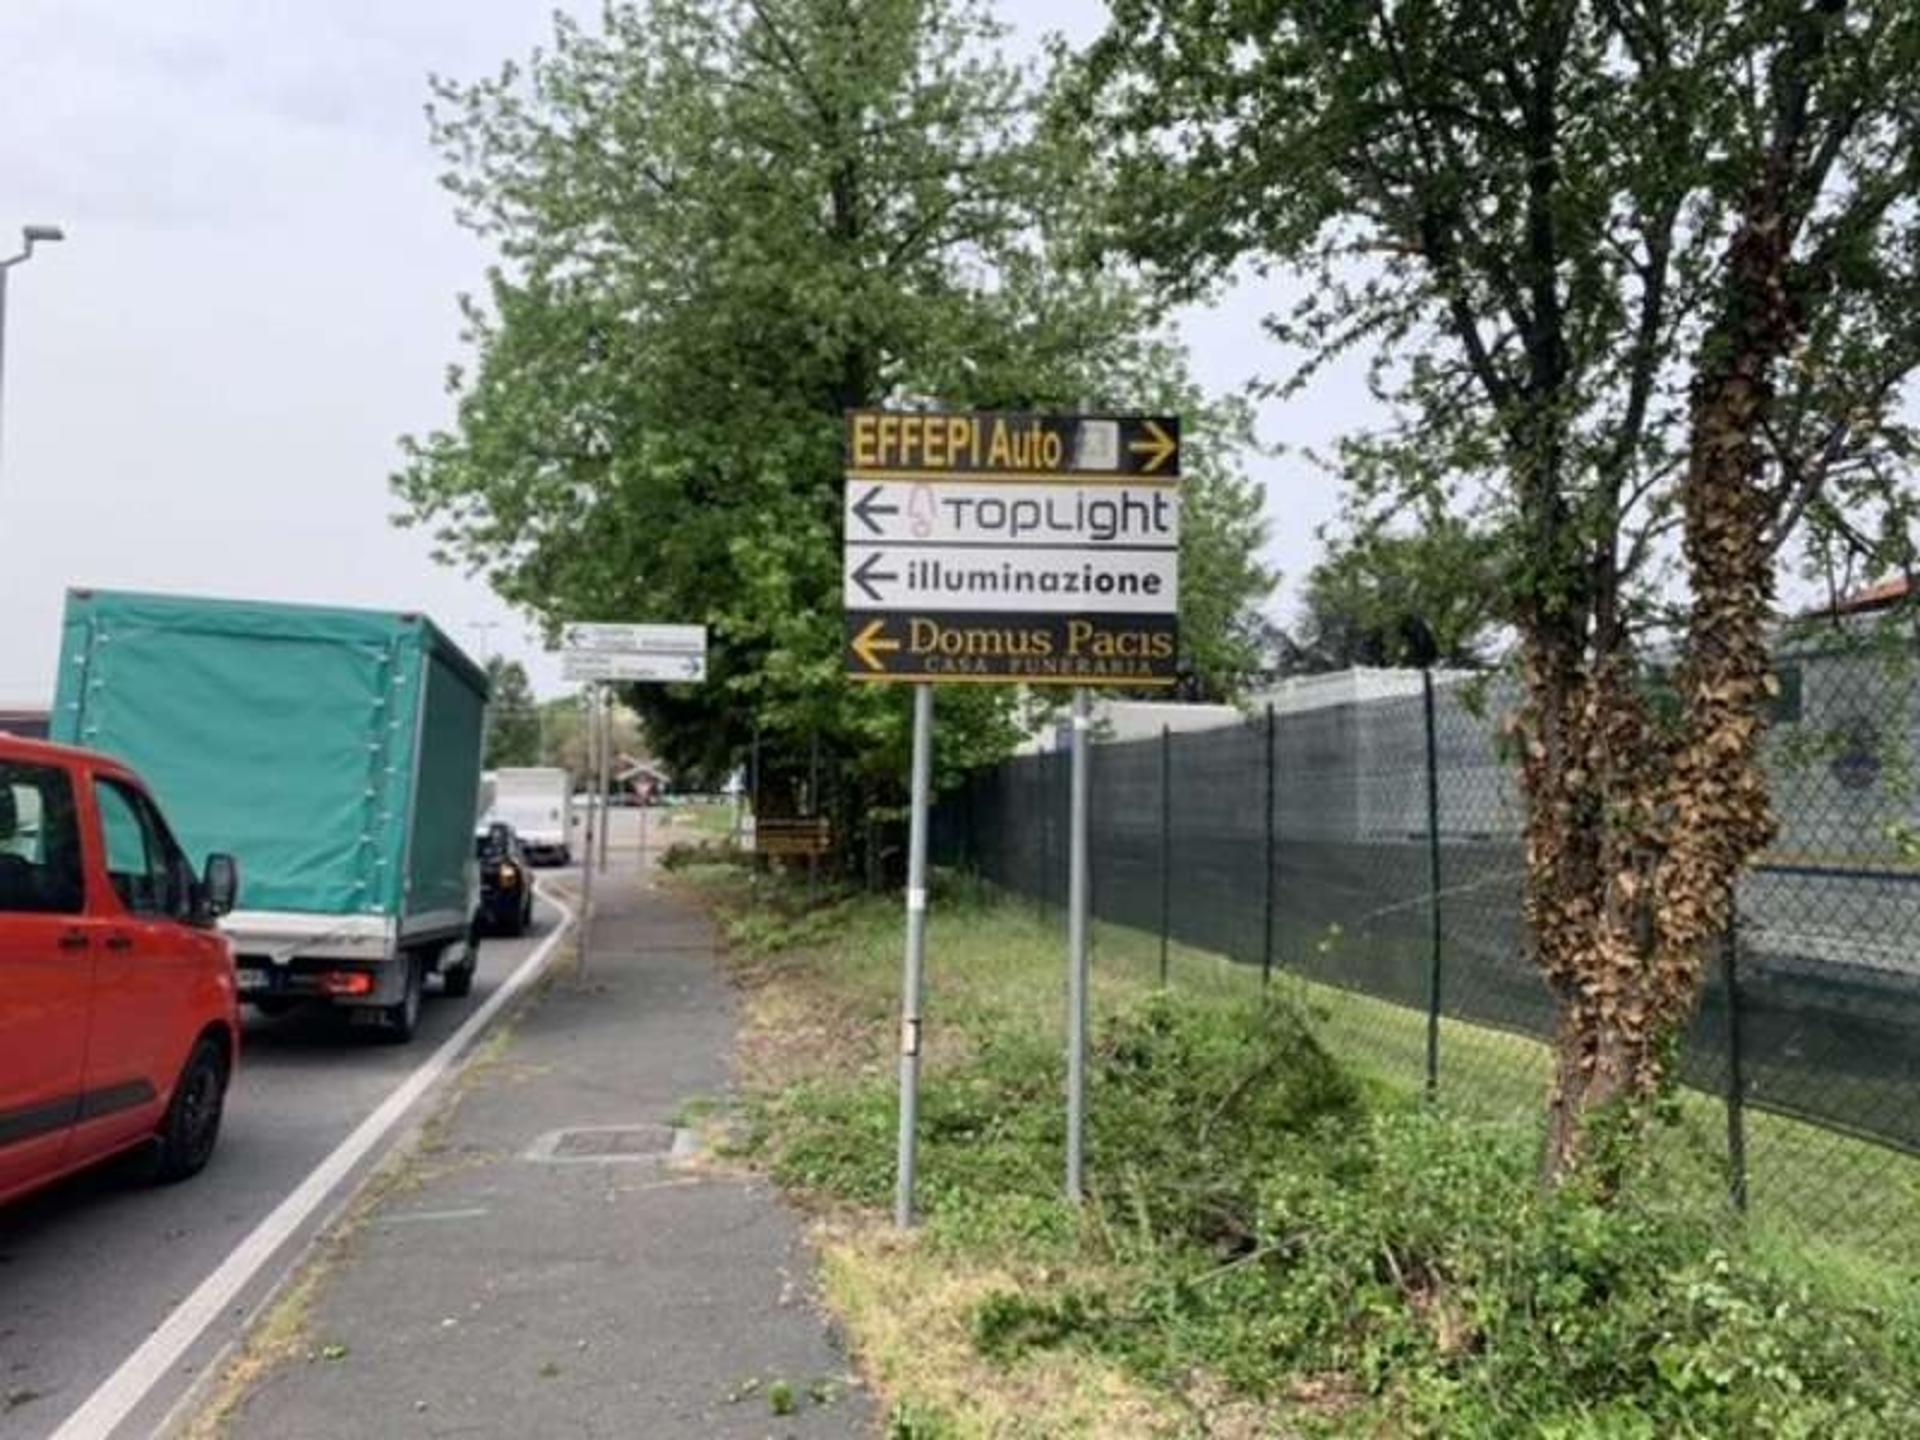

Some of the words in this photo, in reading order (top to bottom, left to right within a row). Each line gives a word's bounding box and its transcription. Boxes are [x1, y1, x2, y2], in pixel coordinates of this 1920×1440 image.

[853, 415, 980, 467] EFFEPI
[988, 418, 1062, 469] Auto
[908, 560, 1162, 595] illuminazione
[909, 617, 1053, 655] Domus
[1067, 619, 1173, 657] Pacis
